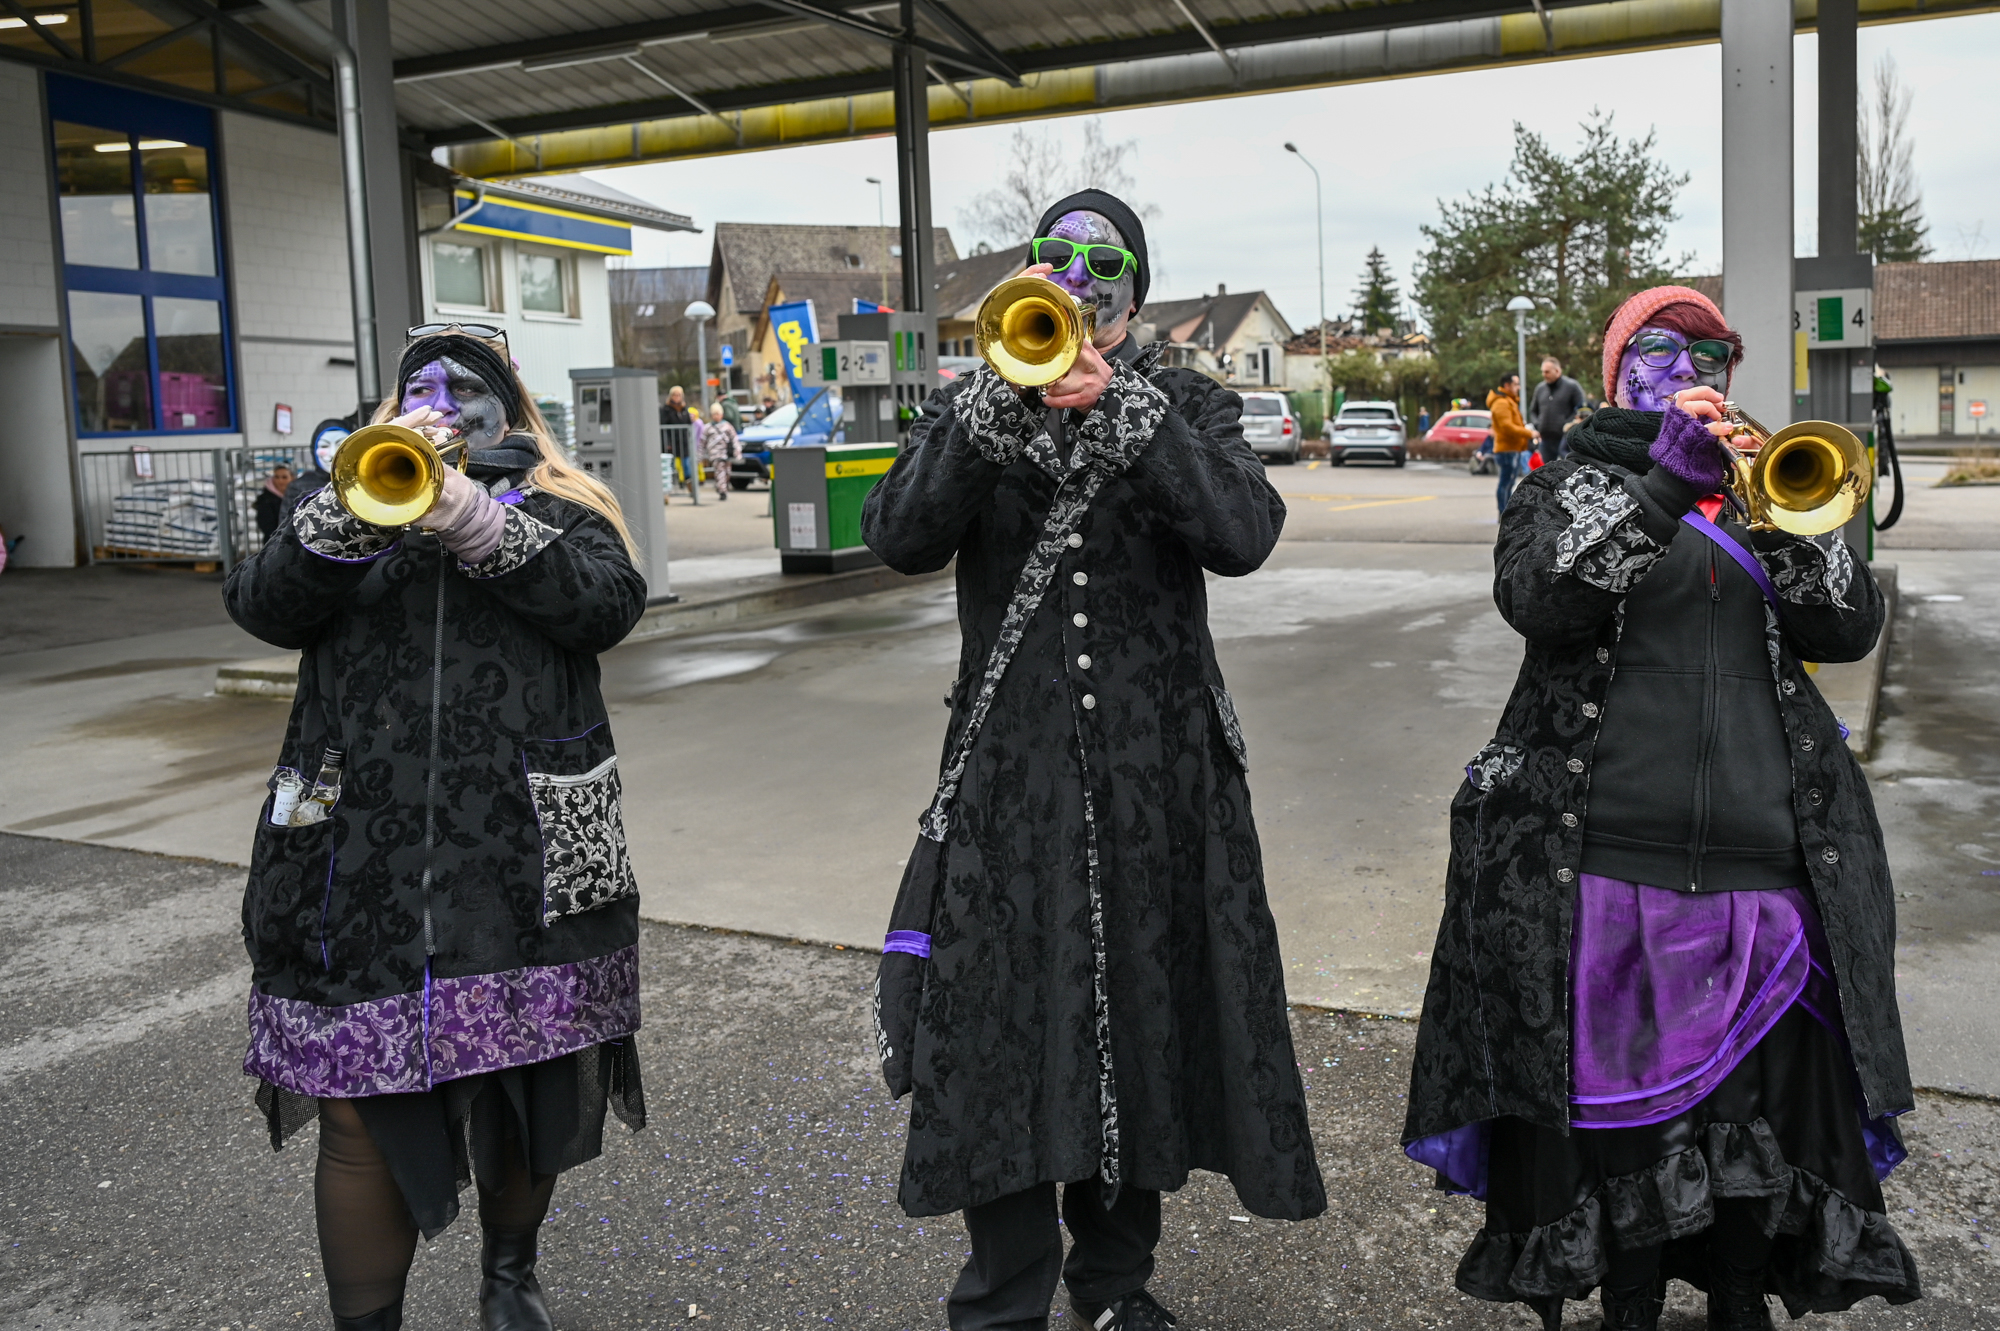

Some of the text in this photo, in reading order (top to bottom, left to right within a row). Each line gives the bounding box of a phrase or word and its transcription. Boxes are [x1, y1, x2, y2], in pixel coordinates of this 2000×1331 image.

[1851, 307, 1864, 328] 4
[803, 357, 810, 373] 1
[841, 355, 849, 372] 2
